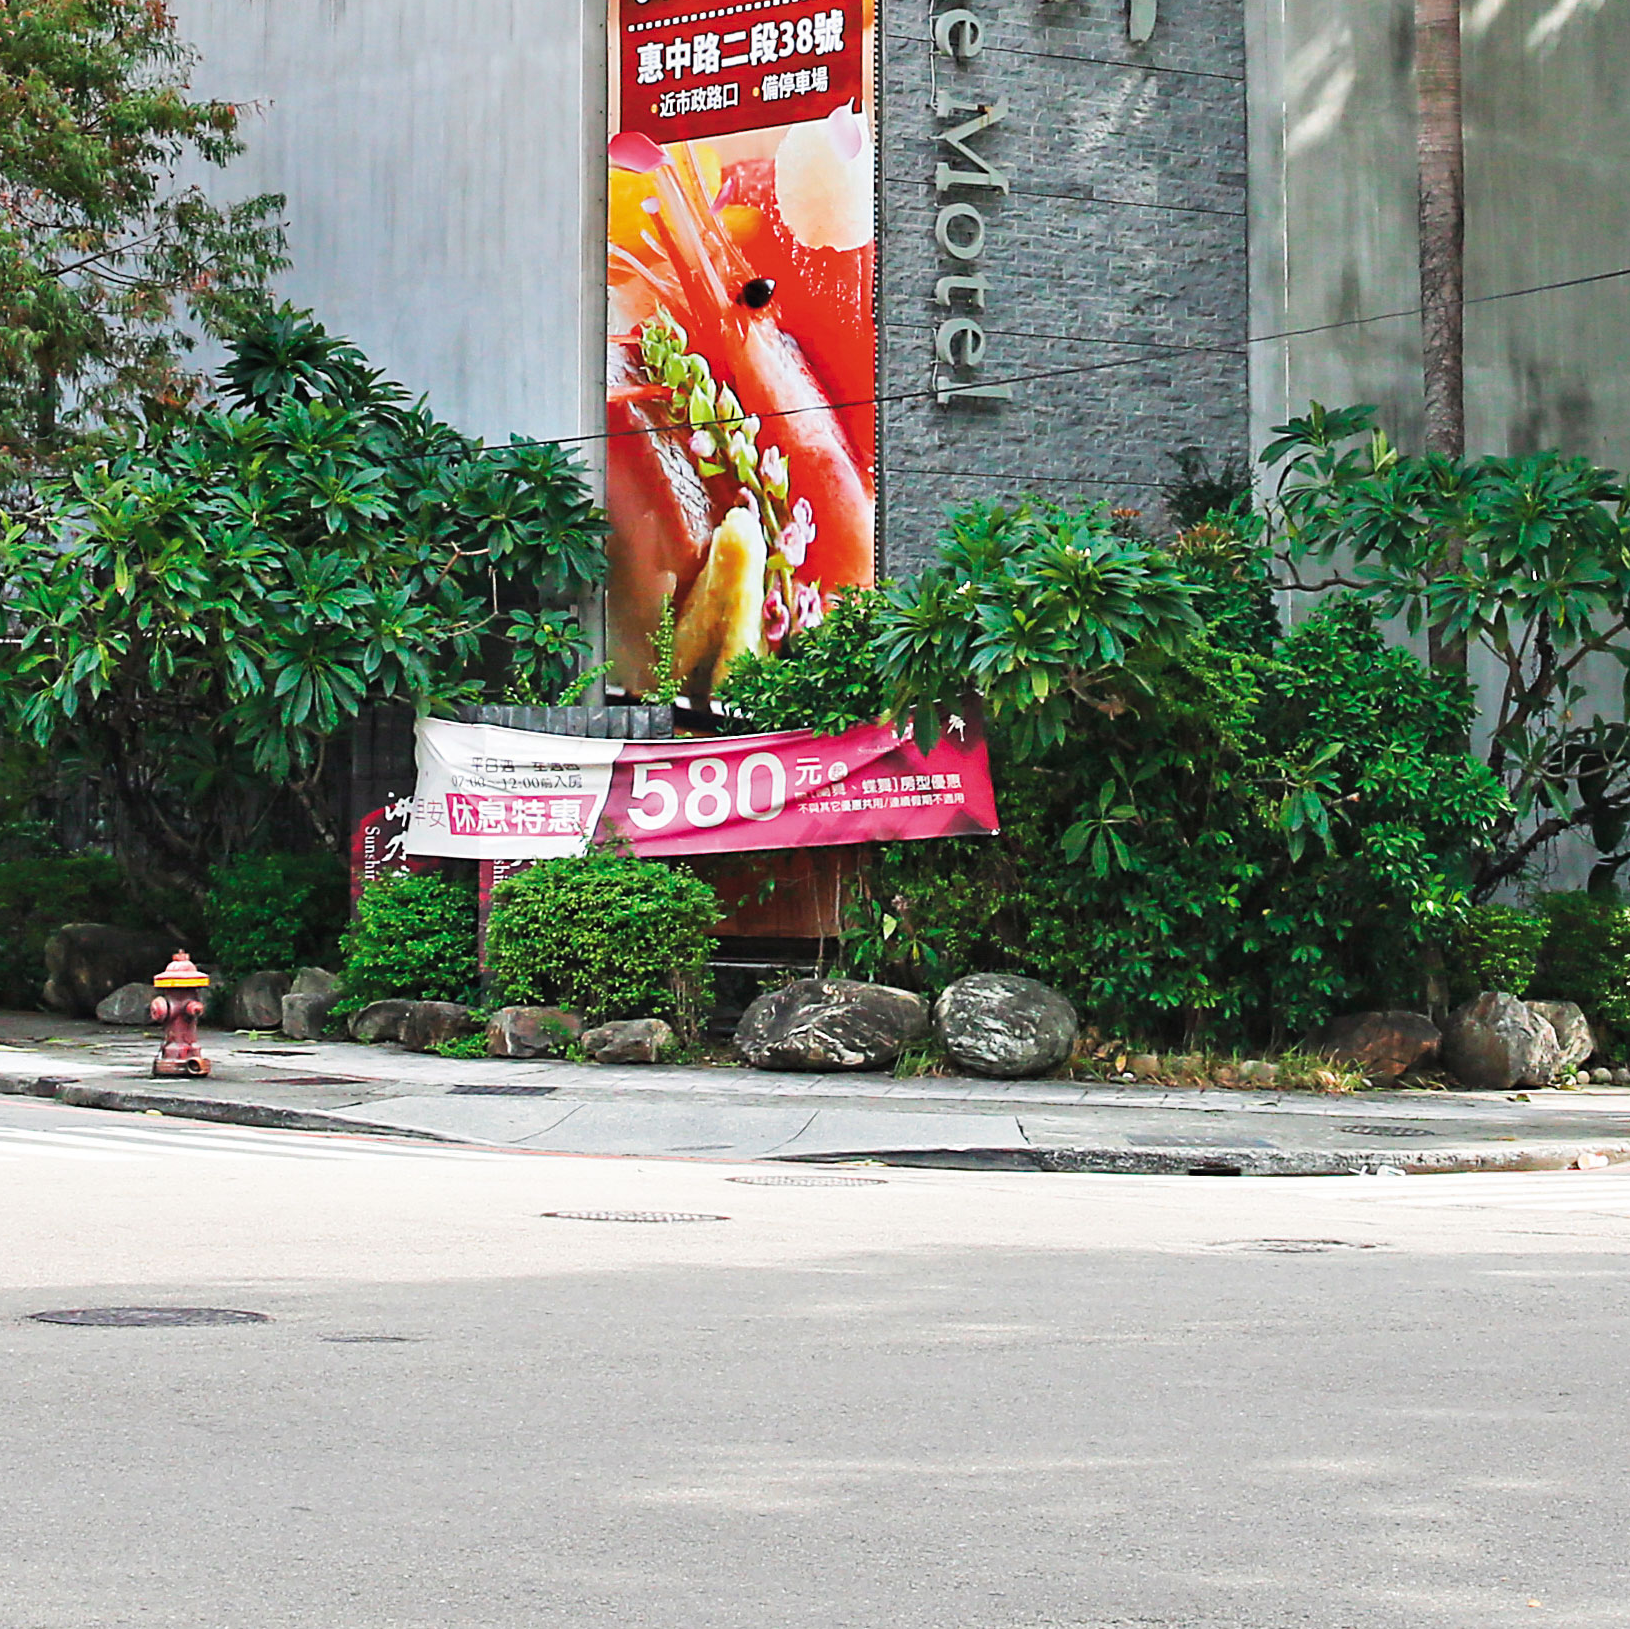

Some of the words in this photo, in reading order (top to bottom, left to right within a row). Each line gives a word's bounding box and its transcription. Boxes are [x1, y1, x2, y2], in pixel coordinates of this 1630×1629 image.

[636, 8, 845, 85] 惠中路二段38號
[933, 92, 1013, 407] Motel
